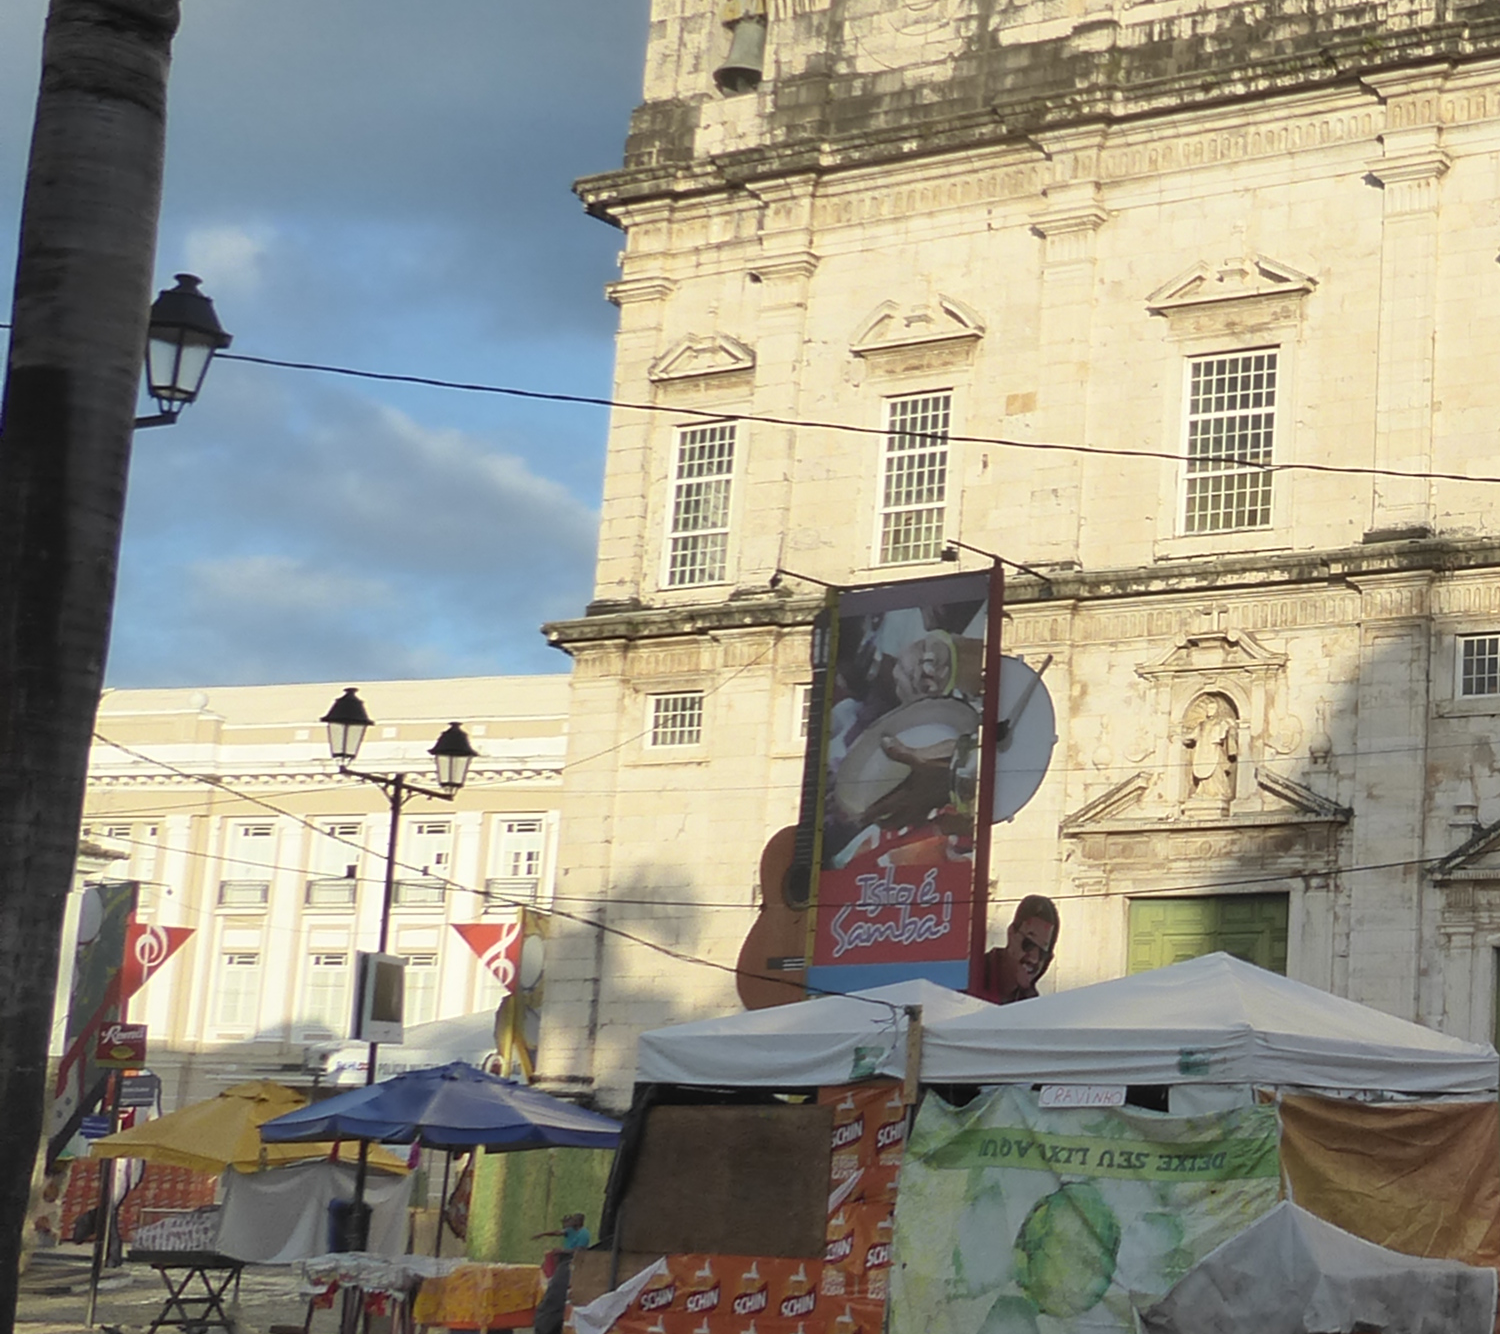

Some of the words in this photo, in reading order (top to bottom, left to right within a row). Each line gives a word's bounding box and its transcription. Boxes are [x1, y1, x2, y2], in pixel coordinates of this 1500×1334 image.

[856, 865, 916, 917] Isto
[918, 868, 940, 907] é
[831, 892, 952, 957] Samba!
[1096, 1149, 1151, 1170] SEU
[1157, 1151, 1227, 1172] DEIXE
[640, 1286, 675, 1311] SCHIN
[686, 1288, 720, 1312] SCHIN
[734, 1291, 767, 1315] SCHIN
[781, 1292, 815, 1316] SCHIN
